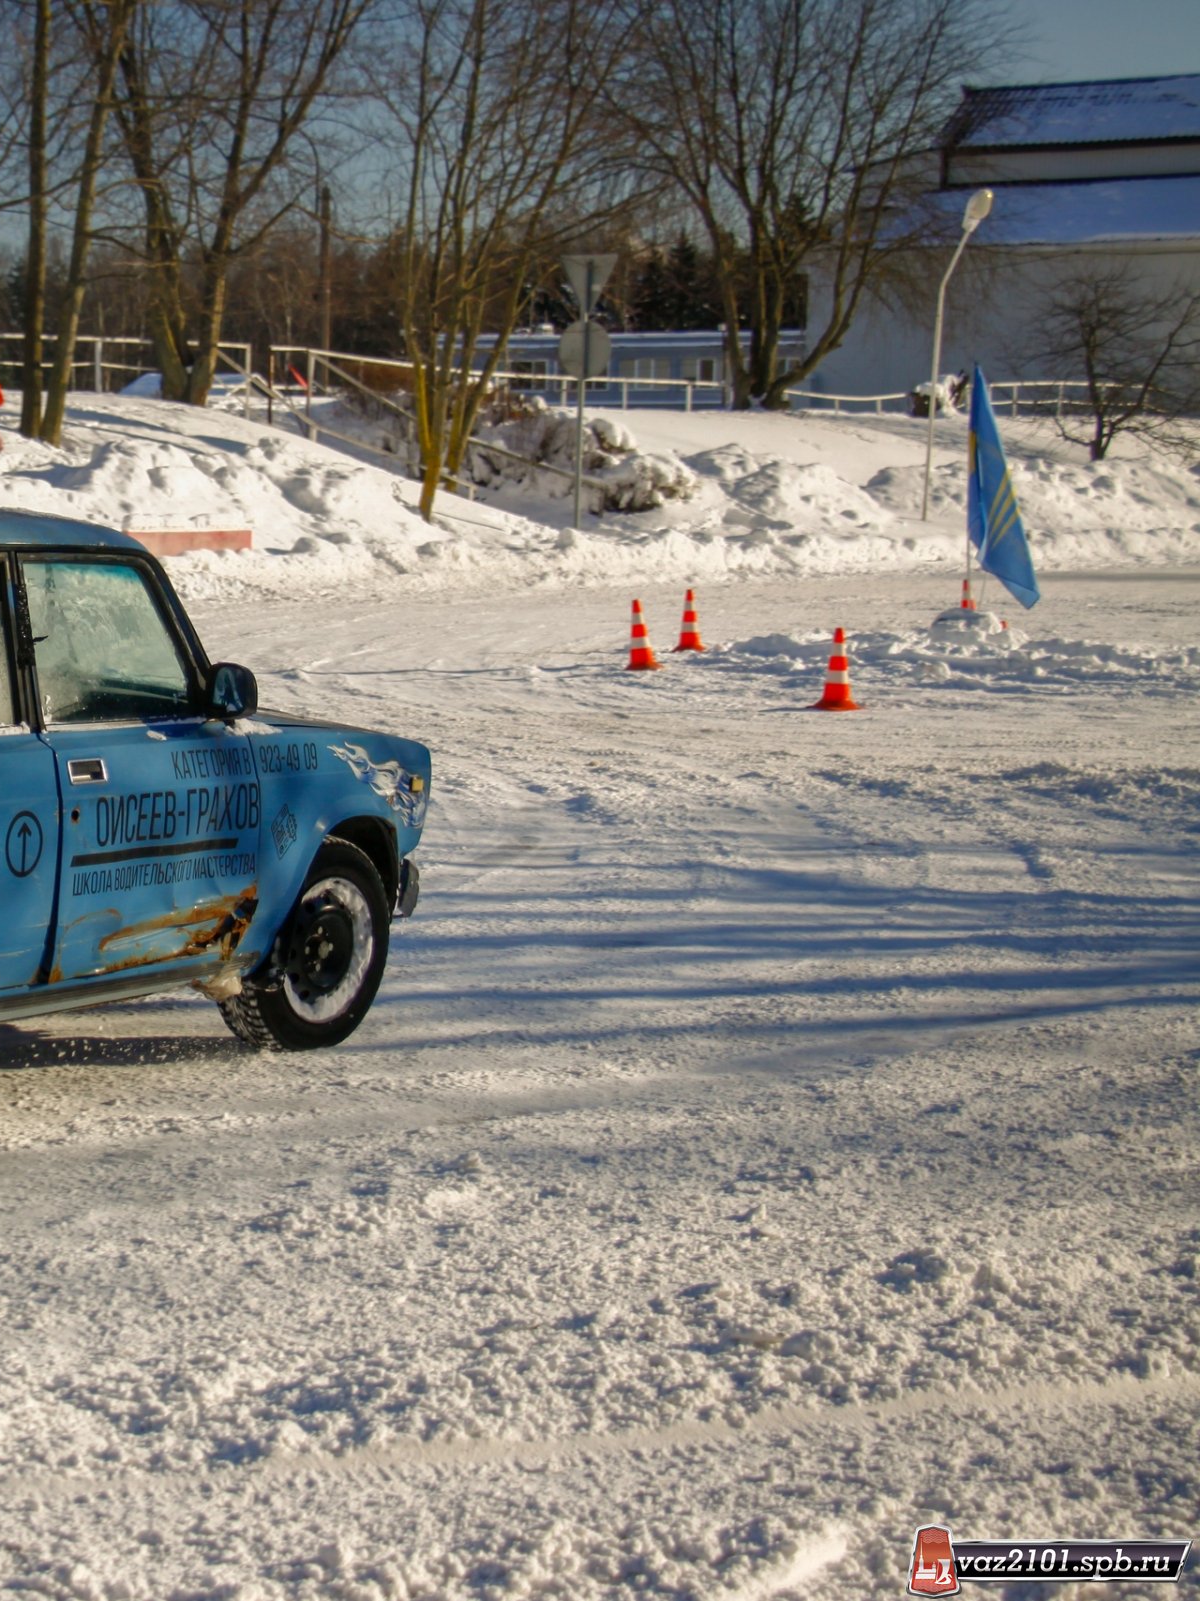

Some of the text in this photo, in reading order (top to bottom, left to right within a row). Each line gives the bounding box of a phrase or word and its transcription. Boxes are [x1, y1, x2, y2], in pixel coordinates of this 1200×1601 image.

[171, 748, 242, 780] КАТЕГОРИЯ
[259, 744, 300, 774] 923-49
[303, 743, 318, 770] 09
[96, 782, 259, 847] ОИСЕЕВ-ГРАХОВ
[72, 853, 256, 897] ШКОЛА ВОДИТЕЛЬСКОГО МАСТЕРСТВА
